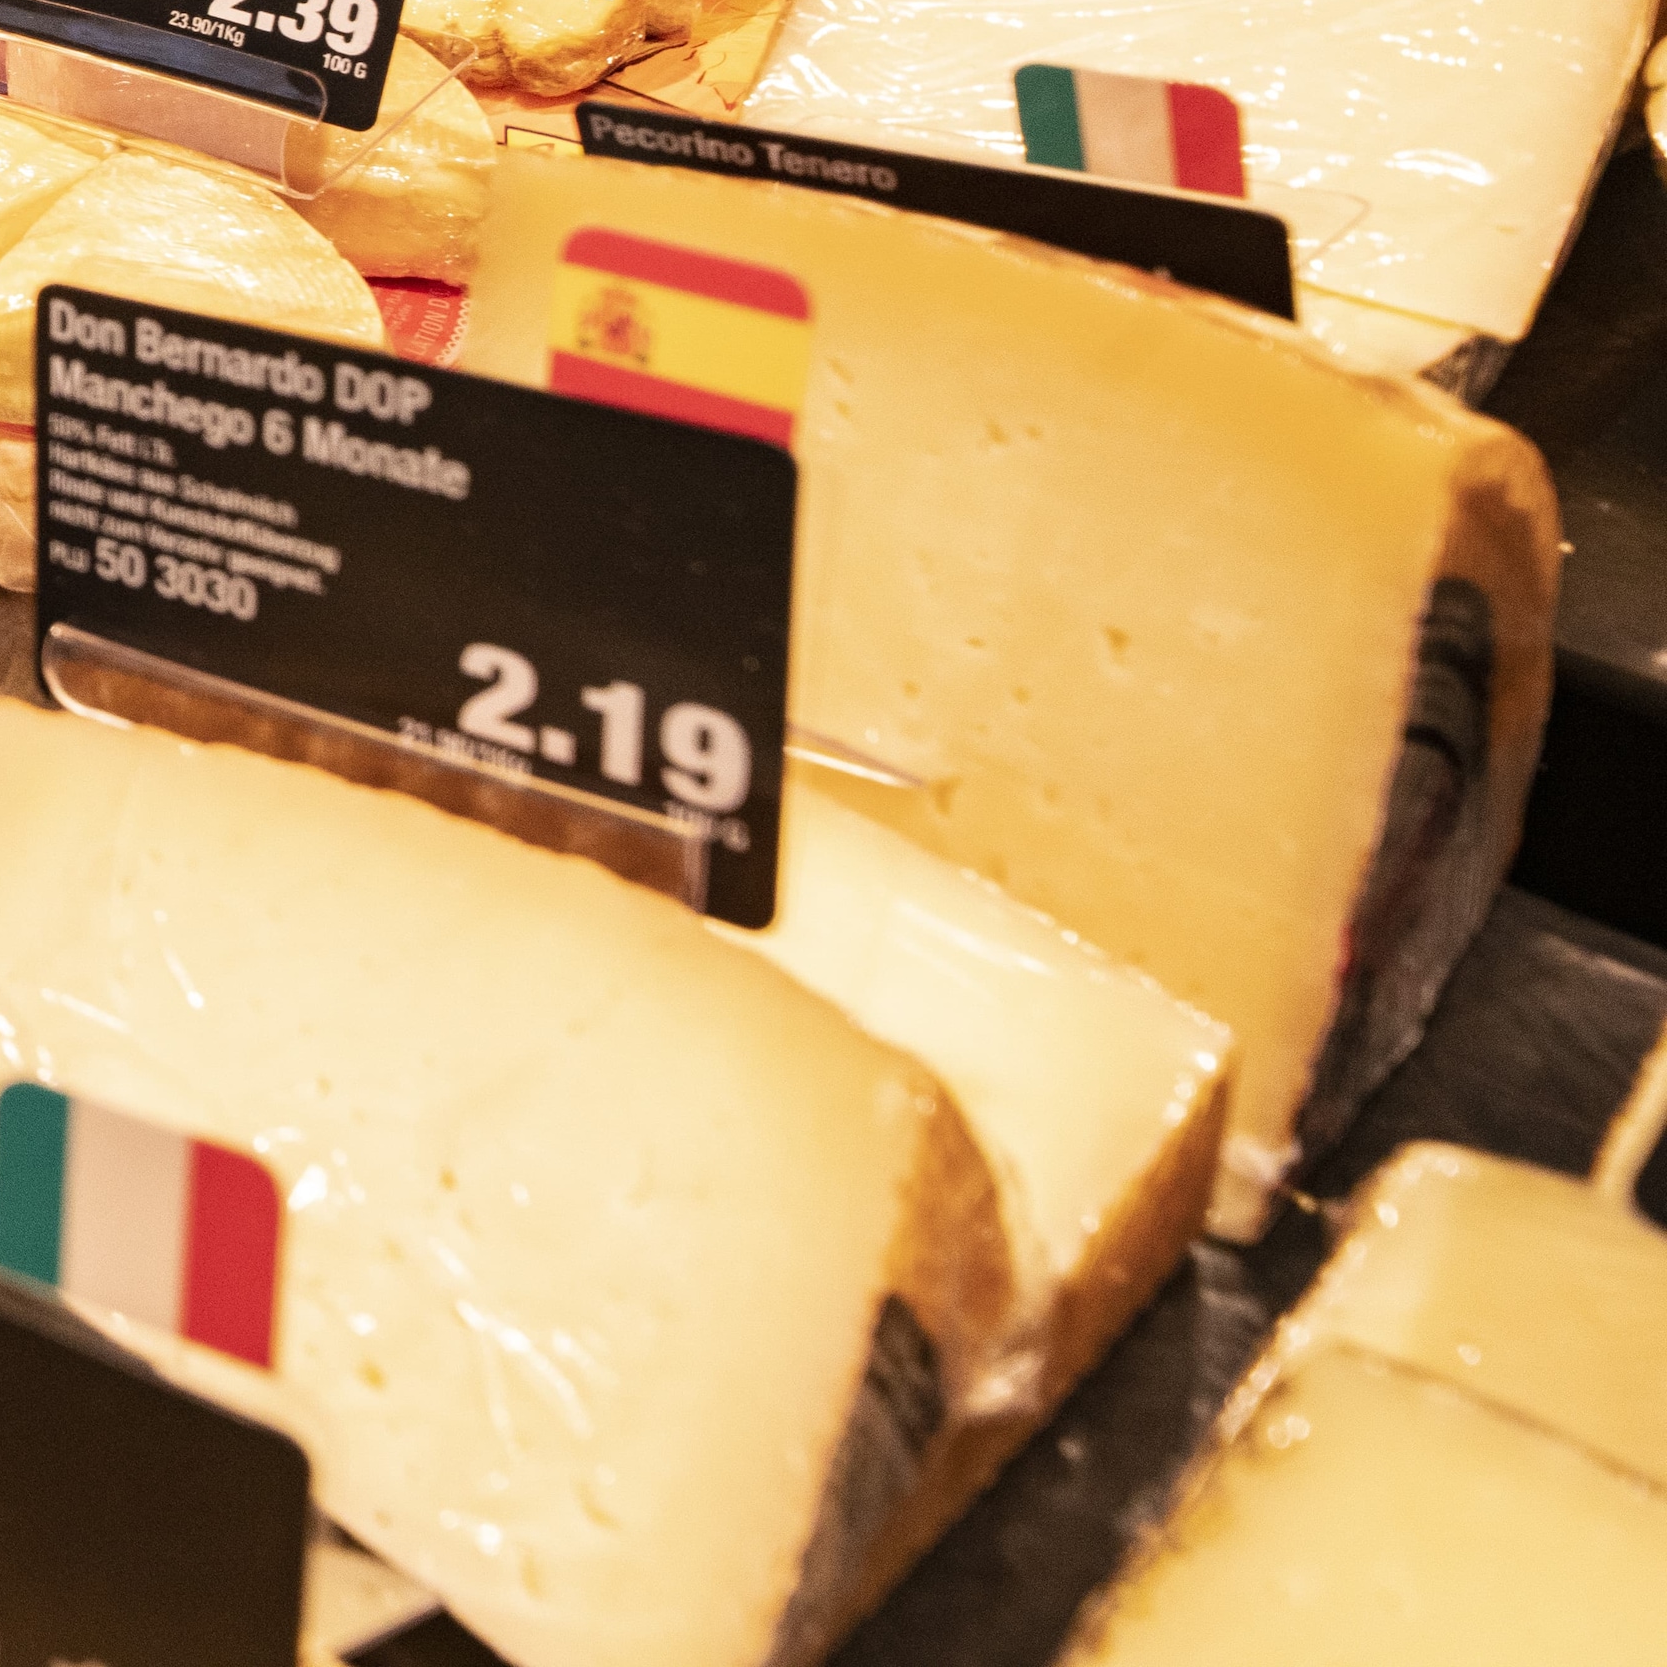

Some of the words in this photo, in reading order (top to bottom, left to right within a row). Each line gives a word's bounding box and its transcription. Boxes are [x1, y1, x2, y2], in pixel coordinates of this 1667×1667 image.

[168, 10, 245, 47] 23.90/1Kg
[322, 52, 352, 74] 100
[354, 62, 367, 79] G
[588, 112, 755, 170] Pecorino
[761, 140, 898, 192] Tenero
[48, 297, 126, 357] Don
[134, 317, 325, 404] Bernardo
[333, 361, 433, 426] DOP
[49, 353, 256, 449] Manchego
[262, 408, 294, 456] 6
[302, 415, 471, 502] Monate
[48, 538, 92, 574] PLU
[94, 535, 148, 589] 50
[153, 554, 260, 622] 3030
[456, 640, 754, 816] 2.19
